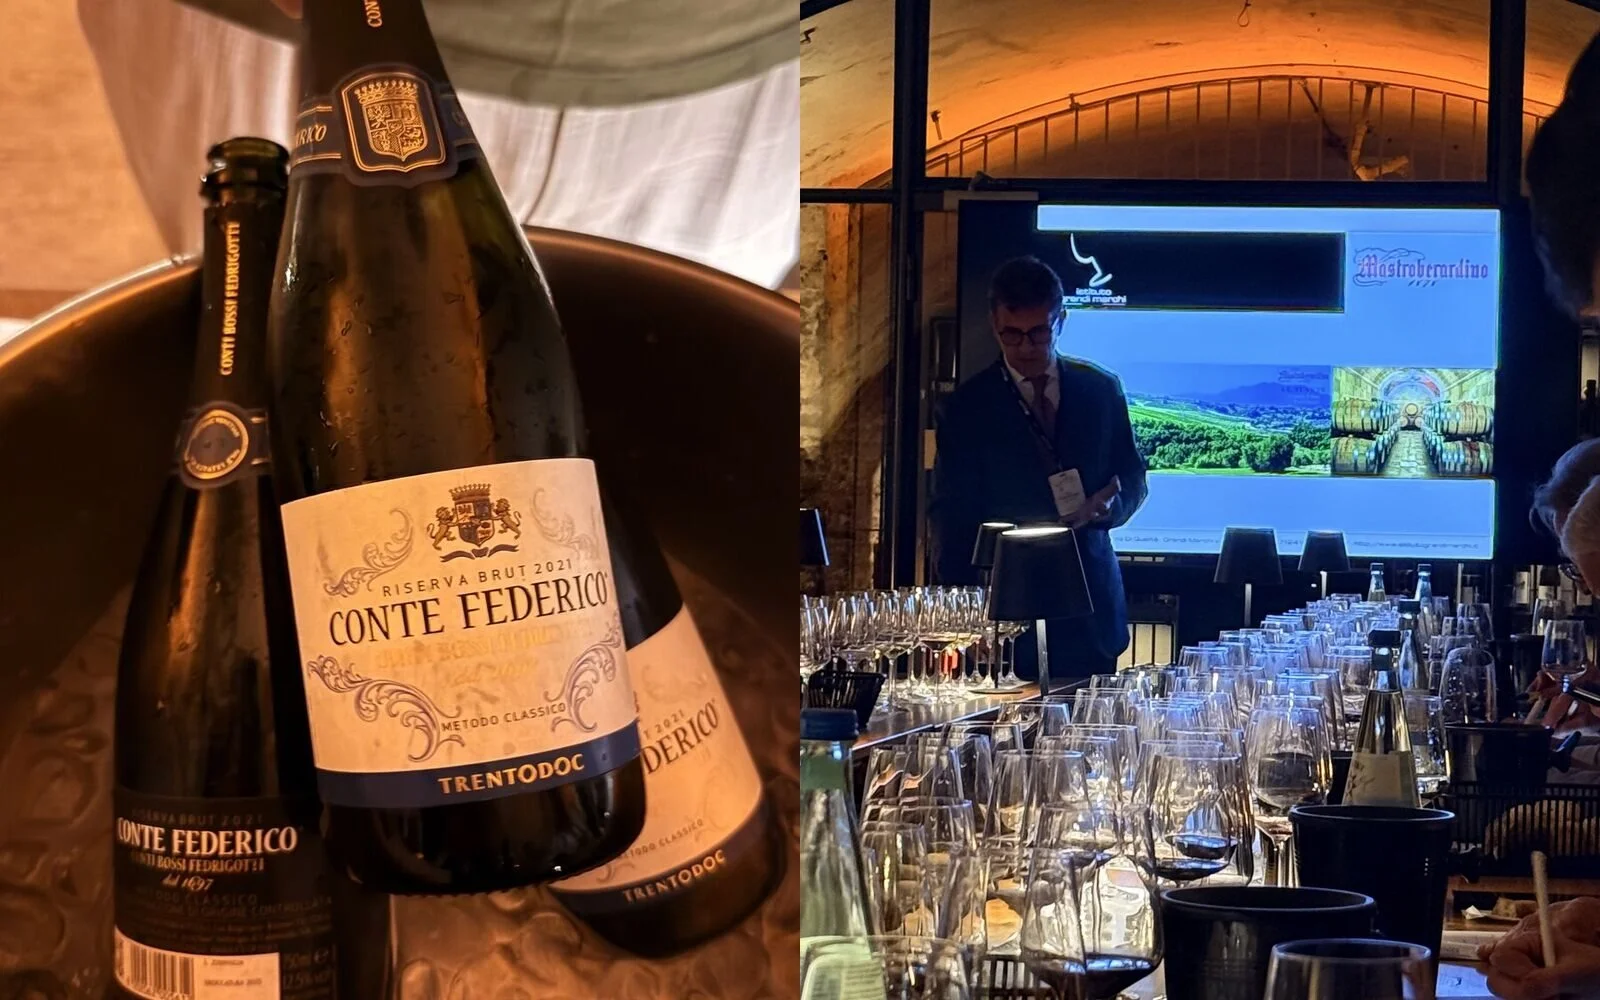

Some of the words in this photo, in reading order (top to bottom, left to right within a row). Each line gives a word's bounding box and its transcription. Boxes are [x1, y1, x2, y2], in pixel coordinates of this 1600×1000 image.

[364, 0, 383, 28] CON
[224, 221, 240, 297] FEDRIGOTTI
[1356, 252, 1489, 280] Mastroberardino
[1075, 287, 1113, 296] istituto
[1092, 295, 1127, 304] marchi
[222, 299, 238, 334] BOSSI
[220, 336, 235, 375] CONTI
[382, 577, 469, 598] RISERVA
[479, 565, 526, 583] BRUT
[534, 558, 573, 575] 2021
[329, 598, 445, 647] CONTE
[458, 570, 608, 629] FEDERICO
[440, 716, 500, 733] METODO
[502, 702, 567, 724] CLASSICO
[640, 701, 718, 774] DERICO
[438, 752, 585, 795] TRENTODOC
[117, 817, 165, 852] CONTE
[171, 825, 298, 856] FEDERICO
[156, 854, 185, 871] BOSSI
[623, 849, 726, 904] TRENTODOC
